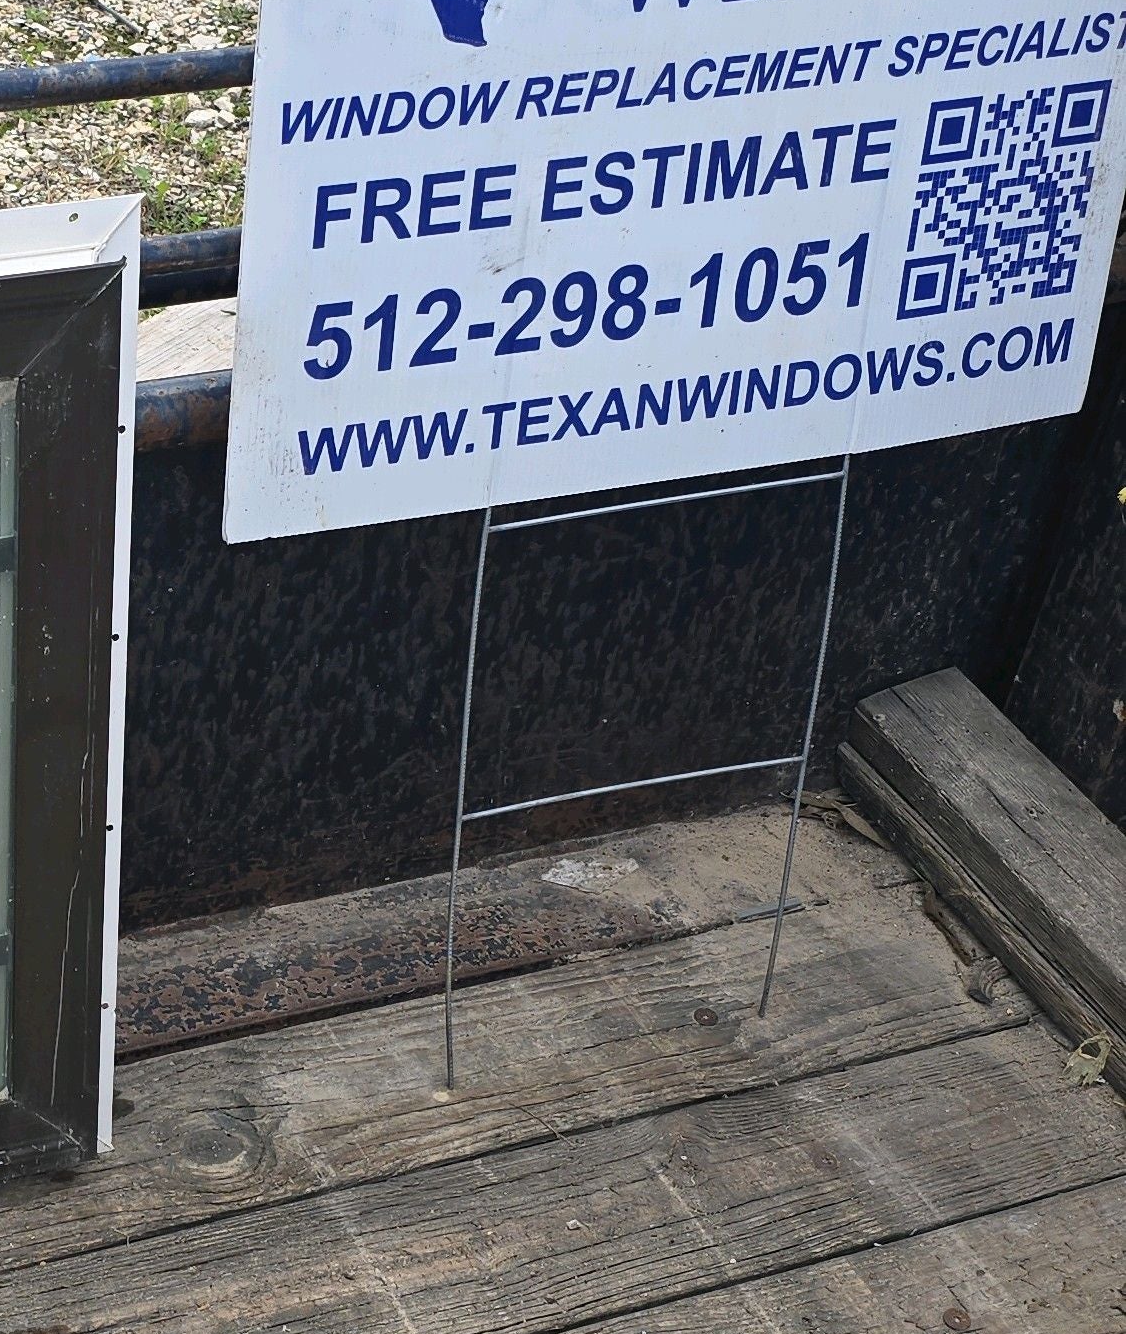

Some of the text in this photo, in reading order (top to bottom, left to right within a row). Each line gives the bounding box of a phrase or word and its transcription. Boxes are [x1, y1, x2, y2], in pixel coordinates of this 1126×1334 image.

[282, 12, 1126, 146] WINDOW REPLACEMENT SPECIALIS
[313, 119, 898, 249] FREE ESTIMATE
[304, 233, 870, 379] 512-298-1051
[298, 318, 1075, 475] WWW.TEXANWINDOWS.COM
